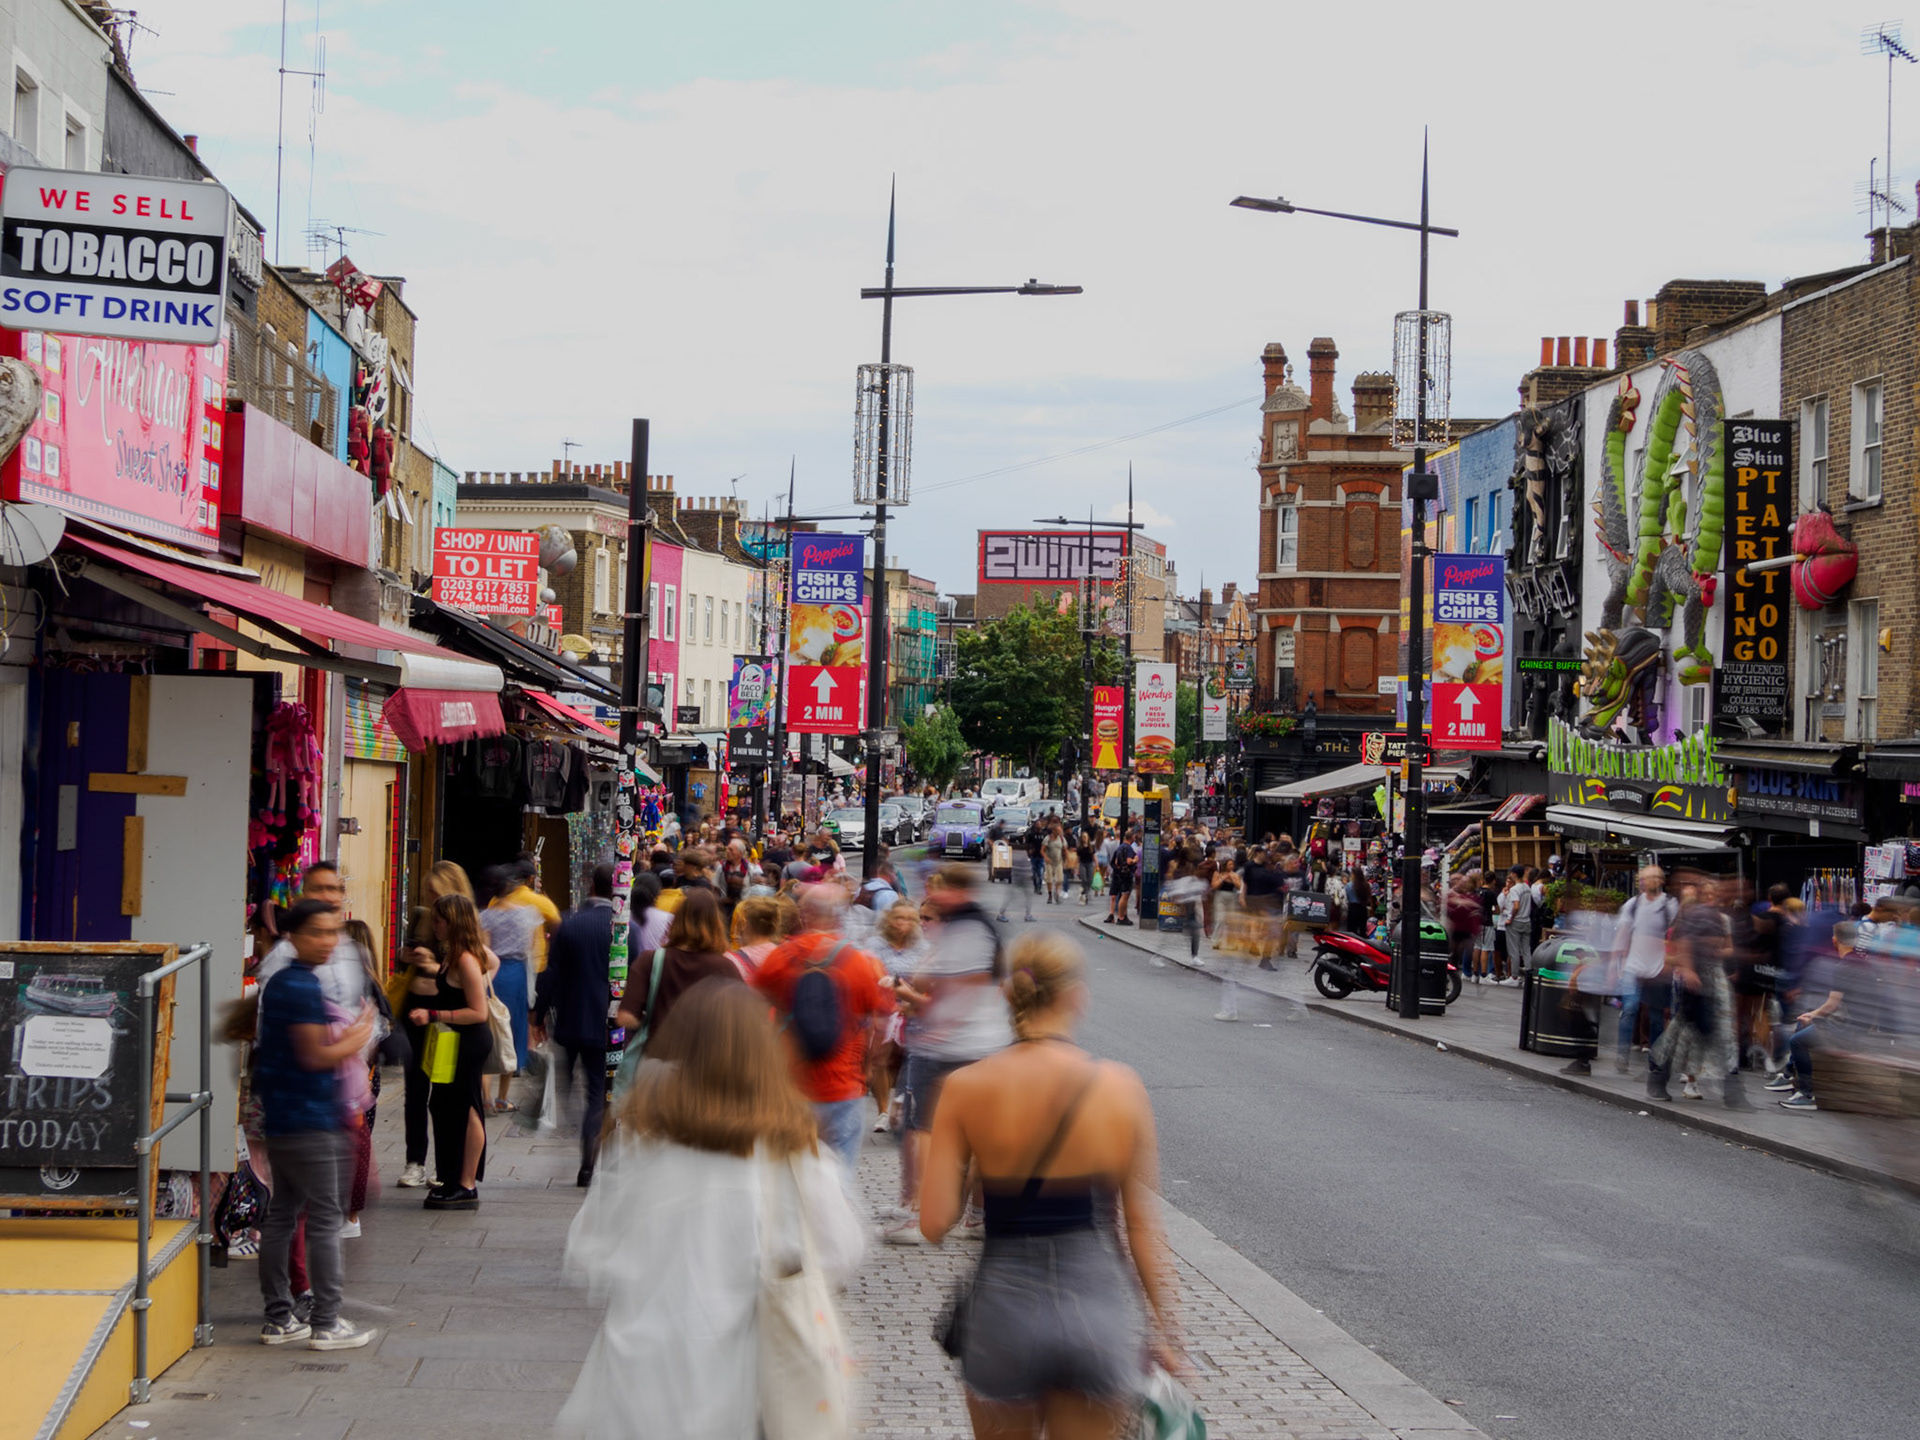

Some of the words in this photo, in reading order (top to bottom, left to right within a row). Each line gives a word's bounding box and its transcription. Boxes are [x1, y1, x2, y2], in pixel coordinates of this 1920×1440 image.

[39, 188, 90, 212] WE
[112, 194, 194, 221] SELL
[16, 226, 215, 287] TOBACCO
[1, 287, 94, 317] SOFT
[103, 296, 215, 328] DRINK
[1732, 425, 1782, 444] Blue
[116, 428, 157, 487] Sweet
[158, 441, 188, 502] Shop
[1732, 448, 1784, 468] Skin
[441, 531, 485, 551] SHOP
[487, 533, 493, 551] /
[497, 534, 534, 553] UNIT
[803, 541, 854, 568] Poppies
[445, 555, 479, 576] TO
[486, 557, 528, 579] LET
[1734, 467, 1759, 661] PIERCING
[1758, 470, 1781, 661] TATTOO
[797, 573, 839, 587] FISH
[842, 572, 857, 588] &
[1444, 562, 1494, 588] Poppies
[441, 579, 473, 591] 0203
[476, 580, 499, 592] 617
[501, 581, 530, 593] 7851
[796, 586, 857, 601] CHIPS
[440, 590, 472, 601] 0742
[475, 591, 498, 603] 413
[500, 593, 530, 605] 4362
[1439, 592, 1481, 606] FISH
[1483, 592, 1498, 606] &
[1439, 605, 1498, 620] CHIPS
[1520, 660, 1553, 670] CHINESE
[1556, 661, 1581, 671] BUFFE
[1721, 663, 1745, 674] FULLY
[1746, 664, 1785, 675] LICENCED
[1723, 674, 1785, 686] HYGIENIC
[1138, 688, 1173, 703] Wendy's
[1721, 685, 1742, 694] BODY
[1742, 686, 1786, 696] JEWELLERY
[1729, 695, 1778, 706] COLLECTION
[803, 707, 813, 720] 2
[815, 707, 843, 720] MIN
[1095, 704, 1122, 713] Hungry?
[1722, 705, 1738, 714] 020
[1740, 706, 1760, 714] 7485
[1762, 706, 1783, 715] 4305
[1447, 722, 1457, 736] 2
[1459, 723, 1486, 737] MIN
[737, 747, 748, 755] MIN
[748, 748, 763, 756] WALK
[1323, 742, 1350, 753] THE
[1387, 742, 1407, 750] TATT
[1547, 716, 1565, 772] ALL
[1568, 733, 1592, 774] YOU
[1595, 746, 1620, 777] CAN
[1625, 752, 1646, 778] EAT
[1650, 746, 1677, 781] FOR
[1747, 767, 1793, 796] BLUE
[1797, 773, 1840, 801] SKIN
[1608, 789, 1626, 801] CAMDEN
[1625, 791, 1643, 804] MARKET
[1738, 796, 1756, 807] TATTOOS
[1756, 798, 1776, 809] PIERCING
[1794, 803, 1820, 815] JEWELLERY
[1826, 806, 1858, 819] ACCESSORIES
[4, 1072, 113, 1111] TRIPS
[0, 1119, 111, 1152] TODAY
